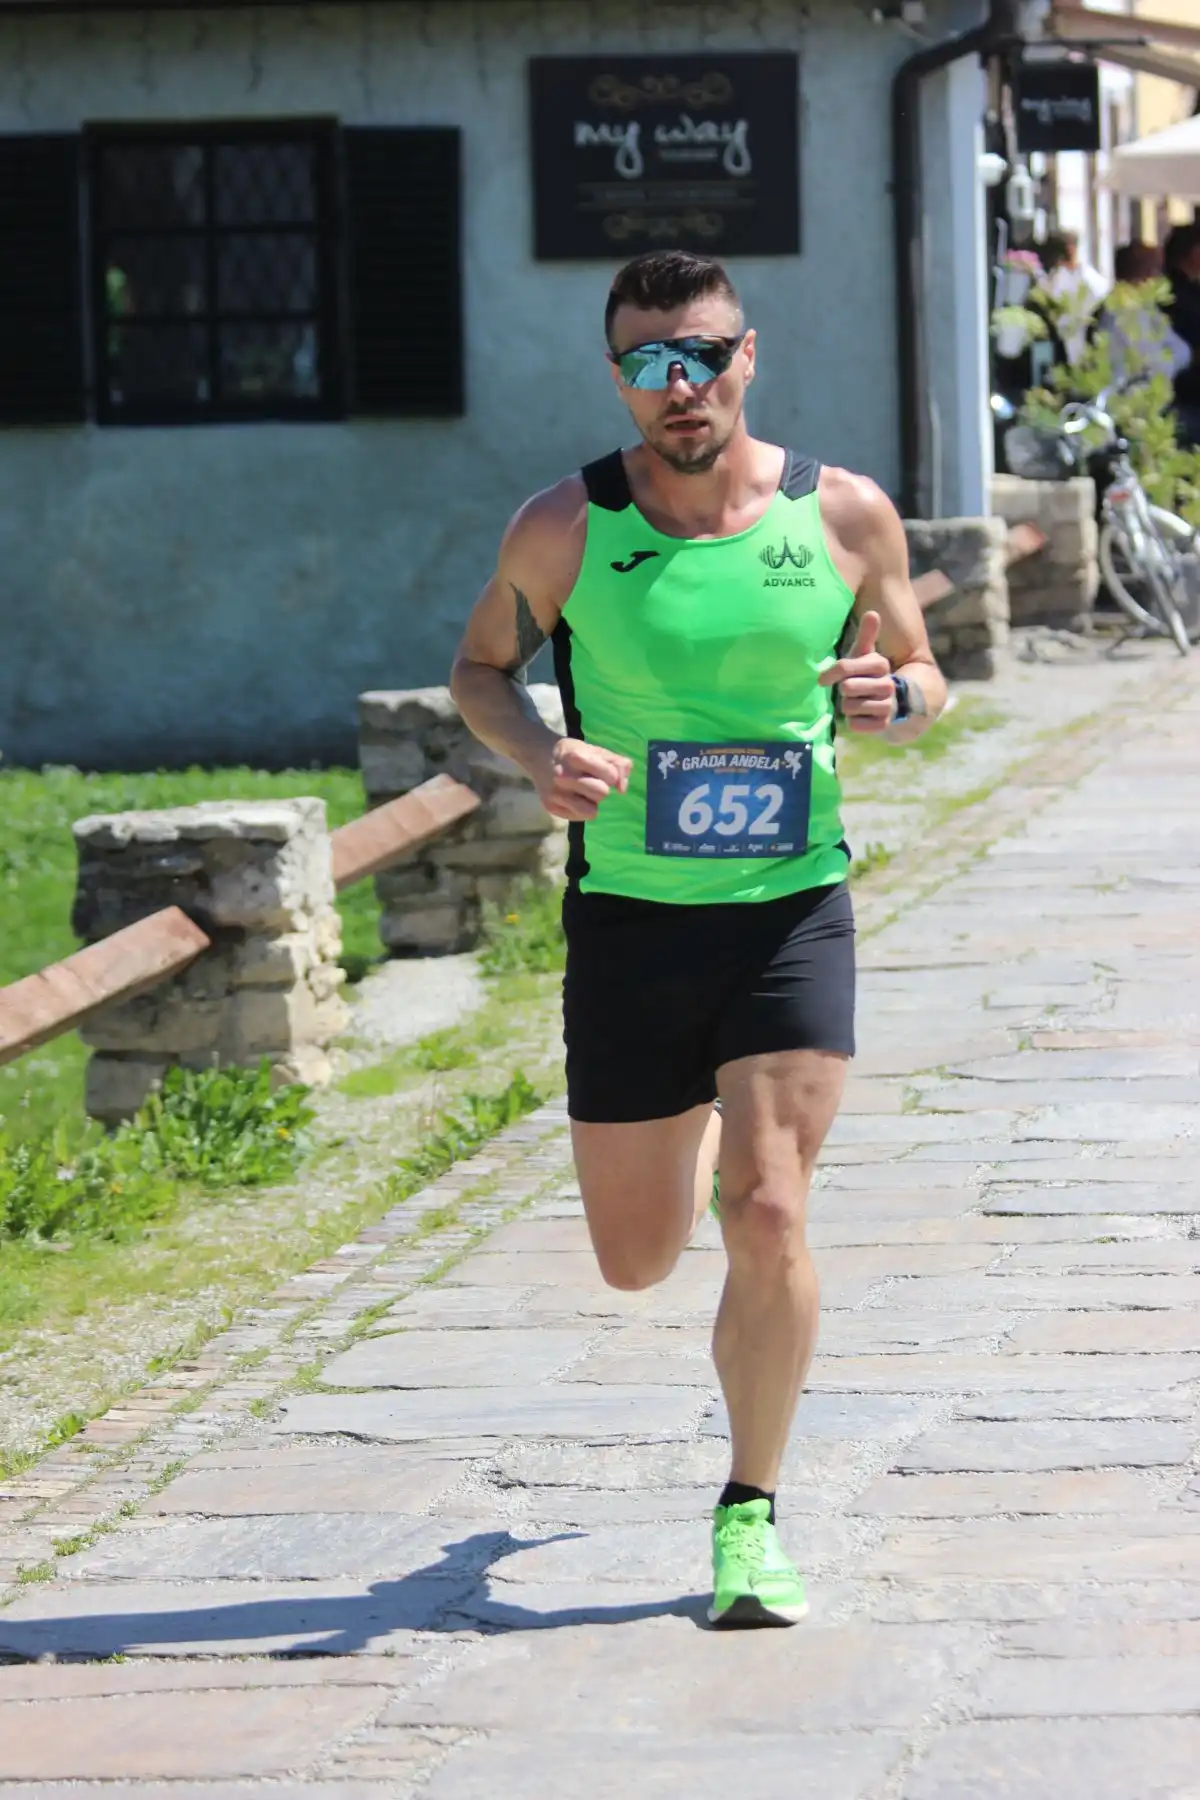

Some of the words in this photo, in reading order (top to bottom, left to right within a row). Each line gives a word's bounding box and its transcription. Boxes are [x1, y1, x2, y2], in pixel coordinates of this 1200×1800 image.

[574, 120, 644, 178] my
[654, 113, 752, 176] way
[763, 577, 816, 587] ADVANCE
[682, 755, 726, 771] GRADA
[678, 783, 784, 836] 652
